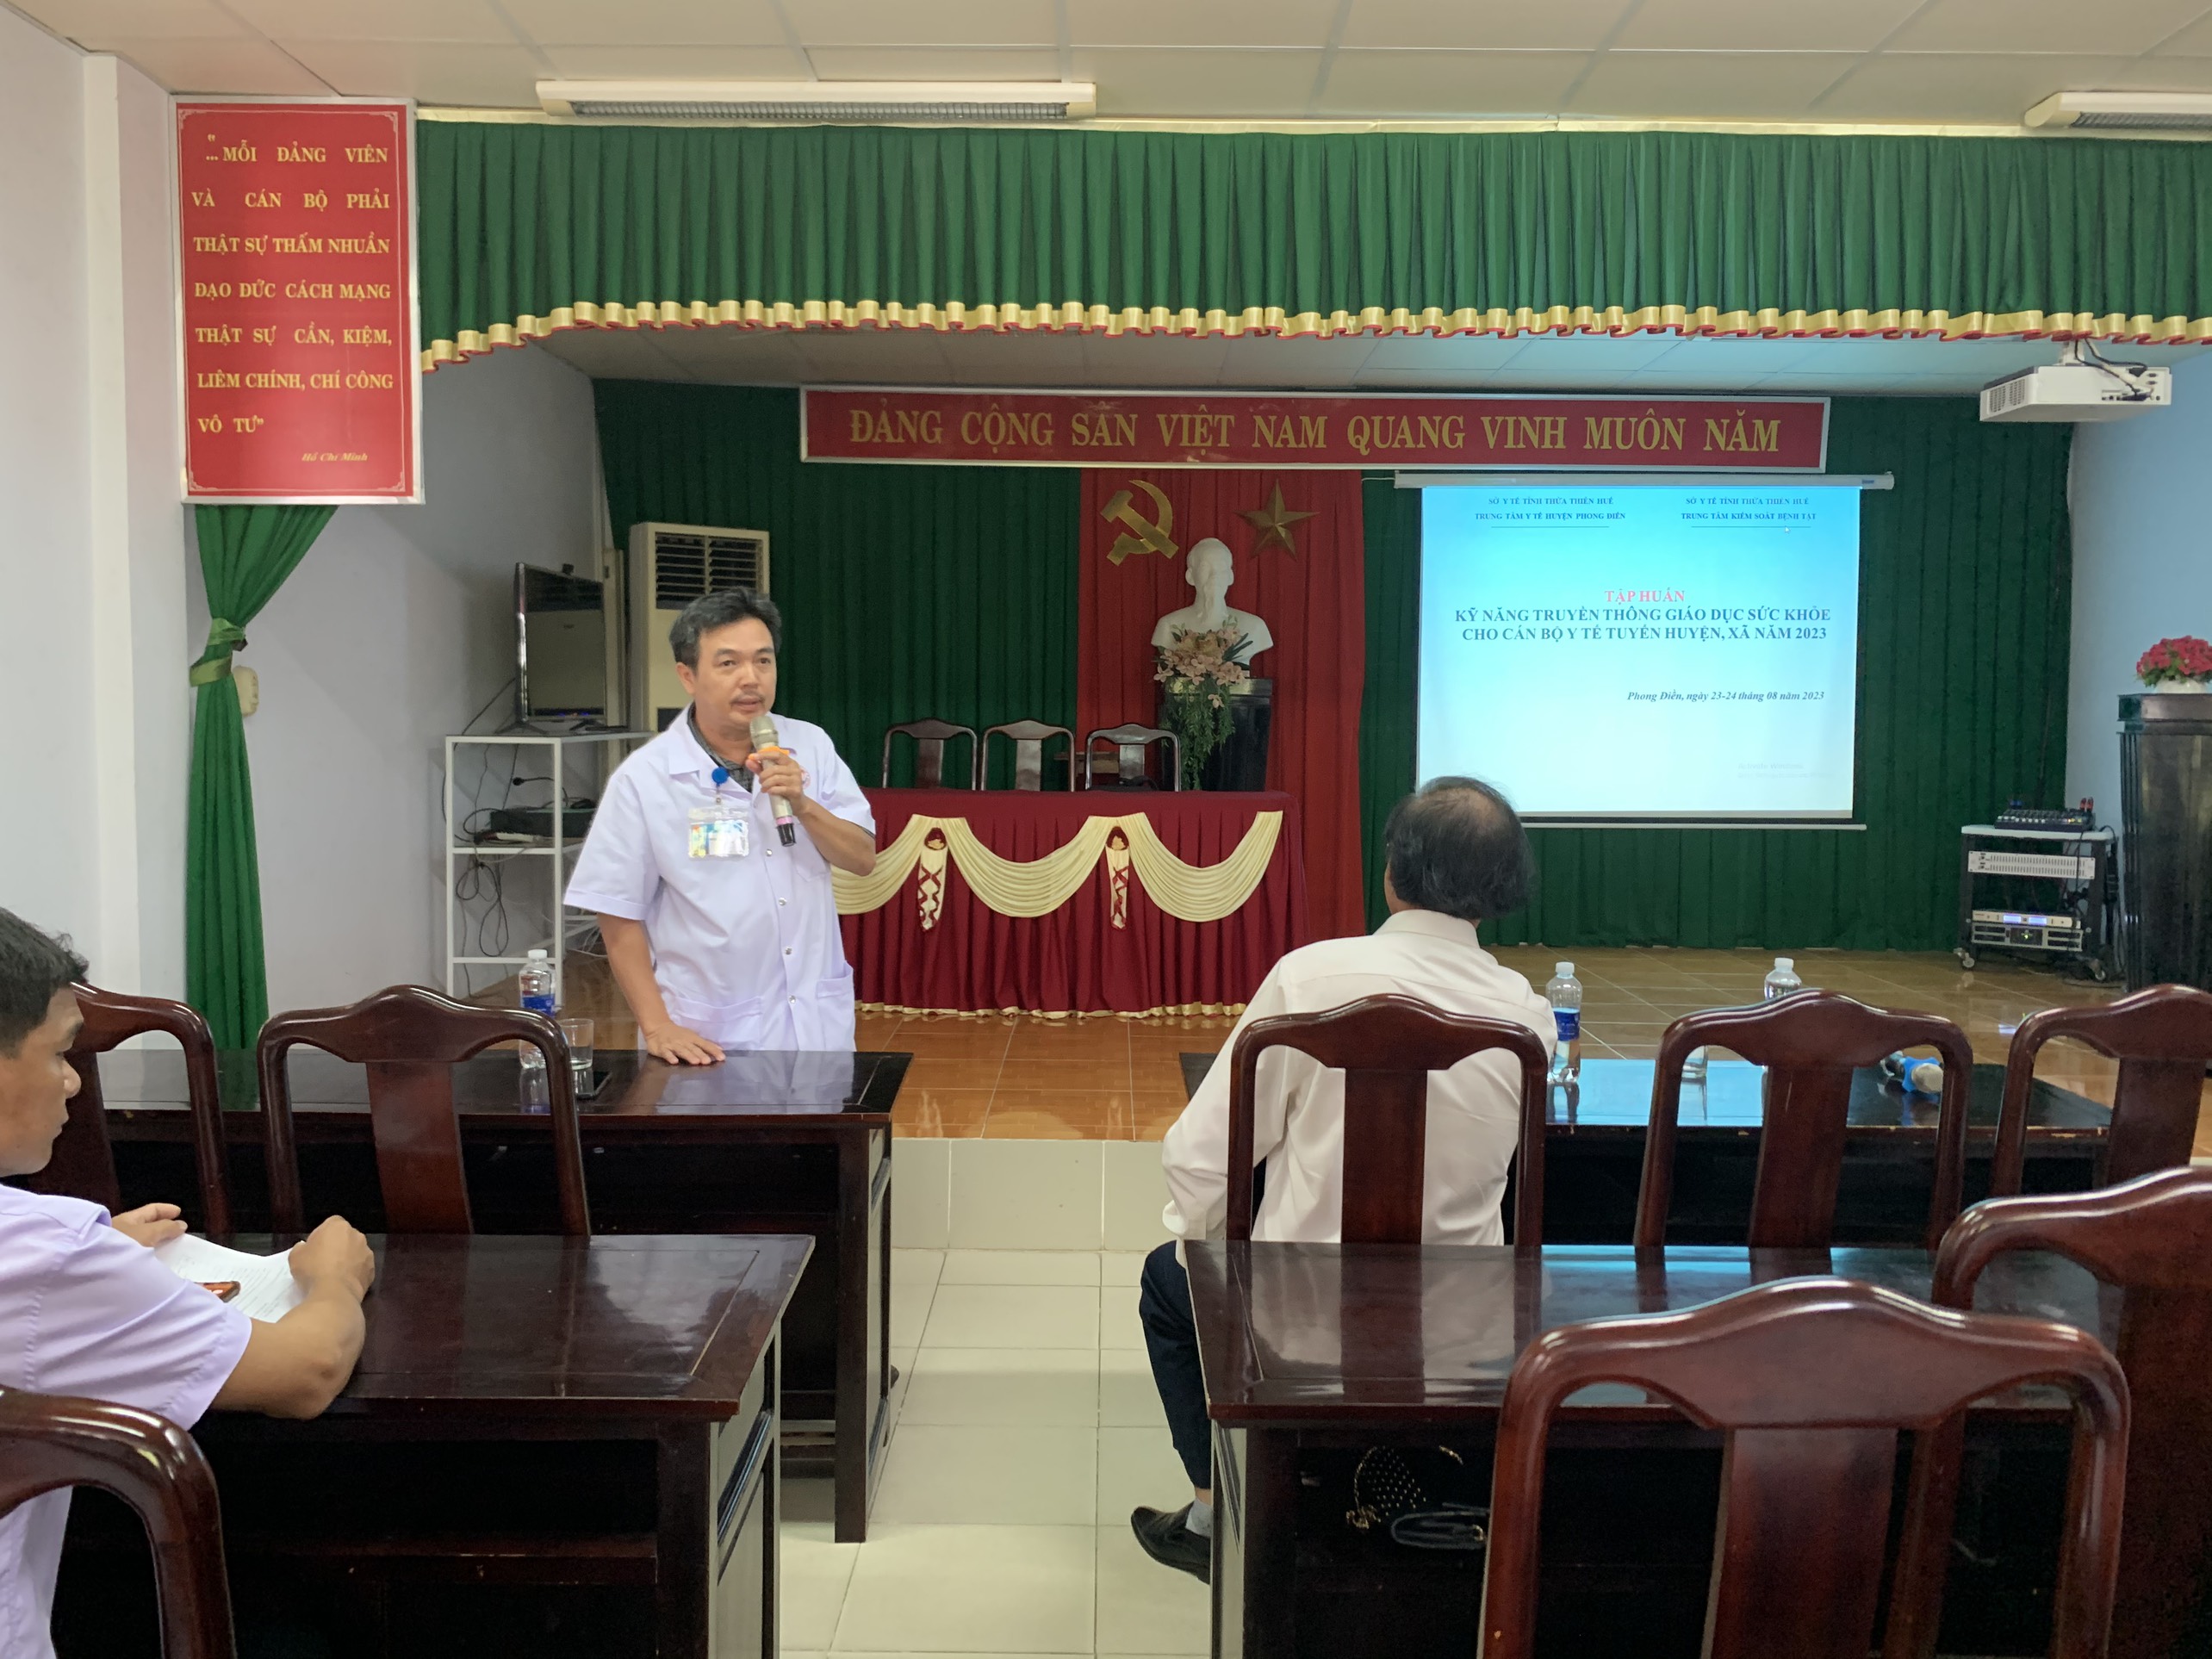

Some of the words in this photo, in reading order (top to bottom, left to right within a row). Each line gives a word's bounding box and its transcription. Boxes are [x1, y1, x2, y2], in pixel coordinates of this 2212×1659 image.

[277, 140, 326, 162] ĐẢNG
[345, 143, 388, 163] VIÊN
[191, 187, 215, 207] VÀ
[245, 188, 282, 208] CÁN
[303, 189, 328, 212] BỘ
[346, 187, 389, 208] PHẢI
[193, 233, 240, 256] THẬT
[245, 234, 268, 256] SỰ
[272, 231, 323, 253] THẤM
[327, 230, 390, 253] NHUẦN
[195, 282, 232, 301] ĐẠO
[239, 278, 276, 298] ĐỨC
[285, 278, 333, 299] CÁCH
[339, 283, 391, 302] MẠNG
[195, 323, 243, 346] THẬT
[252, 325, 276, 346] SỰ
[294, 320, 334, 346] CẦN,
[343, 325, 392, 347] KIỆM,
[197, 369, 240, 388] LIÊM
[245, 369, 305, 391] CHÍNH,
[310, 370, 341, 389] CHÍ
[345, 370, 394, 389] CÔNG
[197, 414, 222, 432] VÔ
[849, 397, 944, 444] ĐẢNG
[960, 402, 1055, 454] CỘNG
[1156, 404, 1235, 456] VIỆT
[1252, 414, 1327, 449] NAM
[1346, 414, 1465, 455] QUANG
[1480, 415, 1567, 450] VINH
[1583, 407, 1686, 450] MUÔN
[1703, 409, 1781, 452] NĂM
[340, 452, 369, 462] Minh
[1605, 588, 1636, 605] TẬP
[1638, 587, 1685, 602] HUẤN
[1455, 606, 1478, 622] KỸ
[1482, 606, 1529, 622] NĂNG
[1532, 606, 1600, 621] TRUYỀN
[1603, 606, 1661, 621] THÔNG
[1665, 606, 1706, 621] GIÁO
[1711, 608, 1744, 624] DỤC
[1748, 606, 1780, 620] SỨC
[1784, 606, 1830, 621] KHỎE
[1462, 628, 1499, 641] CHO
[1502, 624, 1537, 640] CÁN
[1541, 626, 1563, 643] BỘ
[1567, 628, 1577, 639] Y
[1581, 624, 1602, 639] TẾ
[1606, 624, 1662, 639] TUYẾN
[1665, 625, 1725, 642] HUYỆN,
[1728, 624, 1750, 639] XÃ
[1755, 624, 1792, 639] NĂM
[1795, 627, 1827, 639] 2023
[1627, 691, 1657, 702] Phong
[1686, 692, 1708, 702] ngày
[1711, 692, 1737, 700] 23-24
[1738, 691, 1764, 702] tháng
[1767, 692, 1778, 700] 08
[1780, 692, 1800, 700] năm
[1802, 691, 1825, 700] 2023
